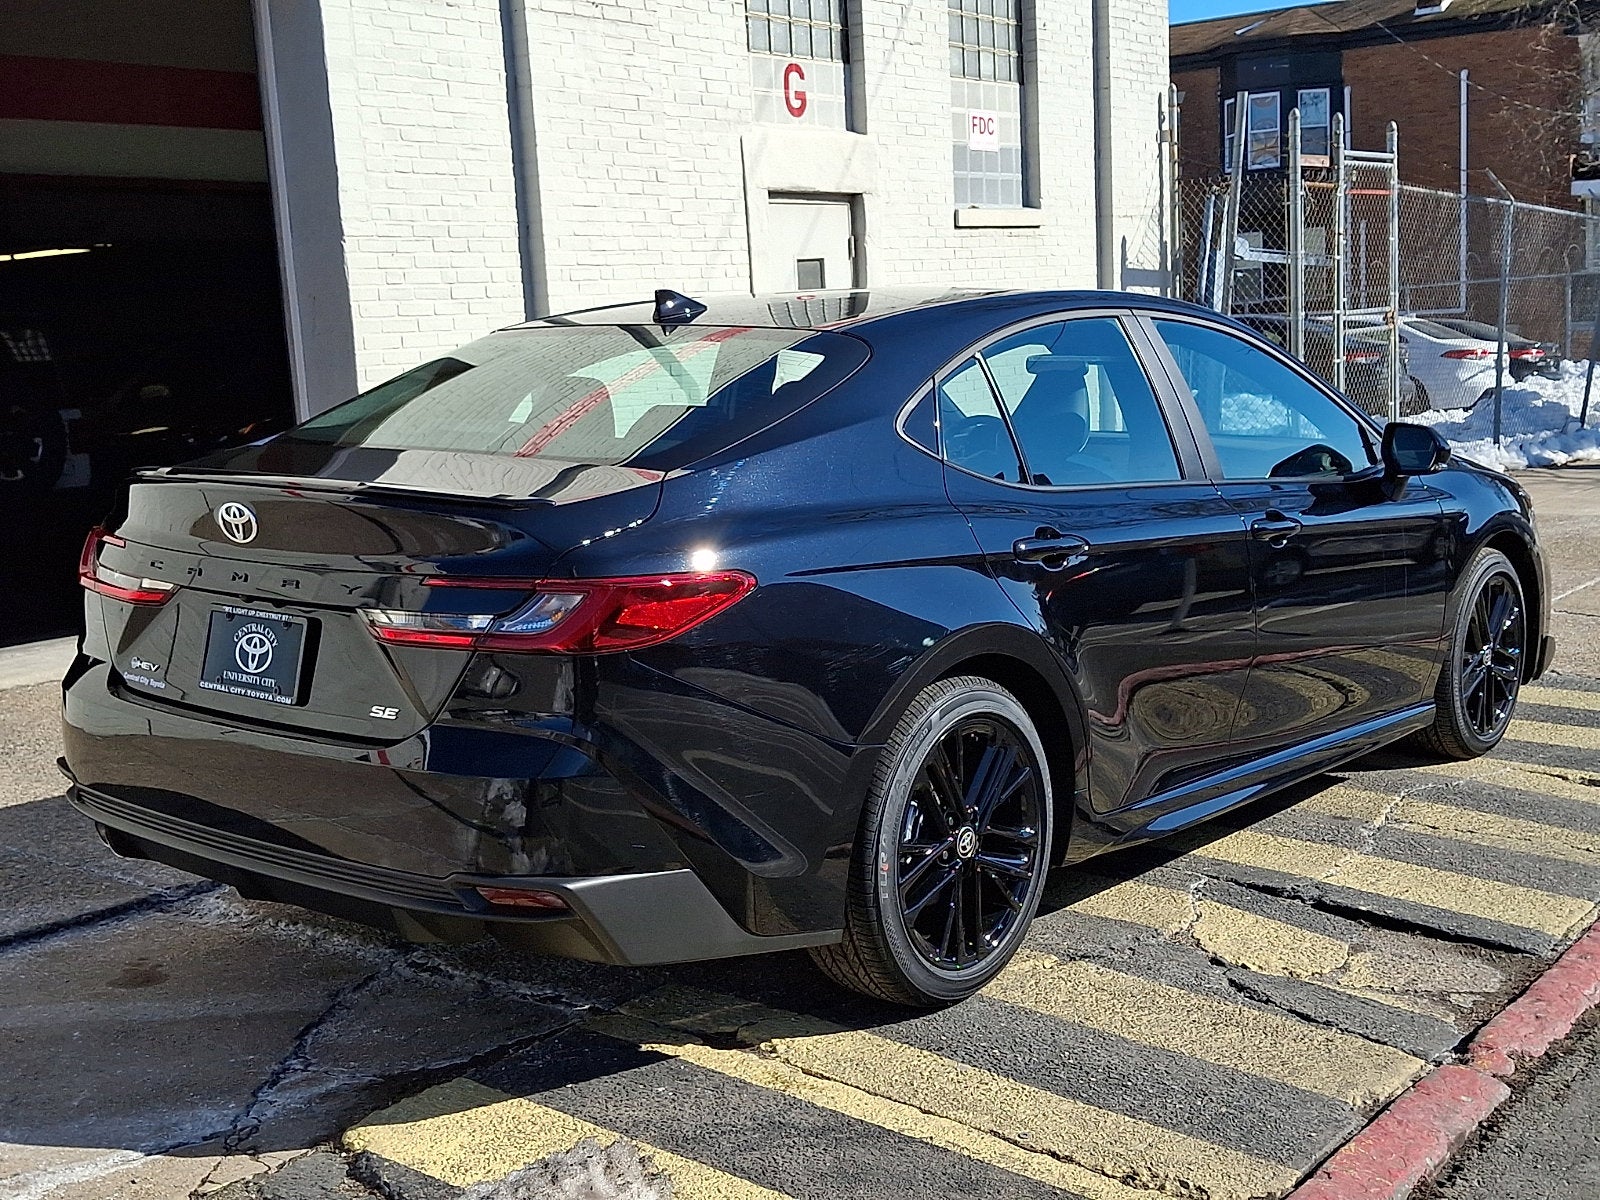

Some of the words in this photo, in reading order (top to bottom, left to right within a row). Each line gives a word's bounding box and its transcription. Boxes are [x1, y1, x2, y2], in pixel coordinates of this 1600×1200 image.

[783, 63, 807, 118] G
[972, 115, 995, 136] FDC
[150, 559, 362, 595] CAMRY
[233, 622, 265, 642] CENTRAL
[264, 627, 279, 648] CITY
[223, 670, 261, 685] UNIVERSITY
[261, 677, 276, 688] CITY
[369, 705, 400, 720] SE
